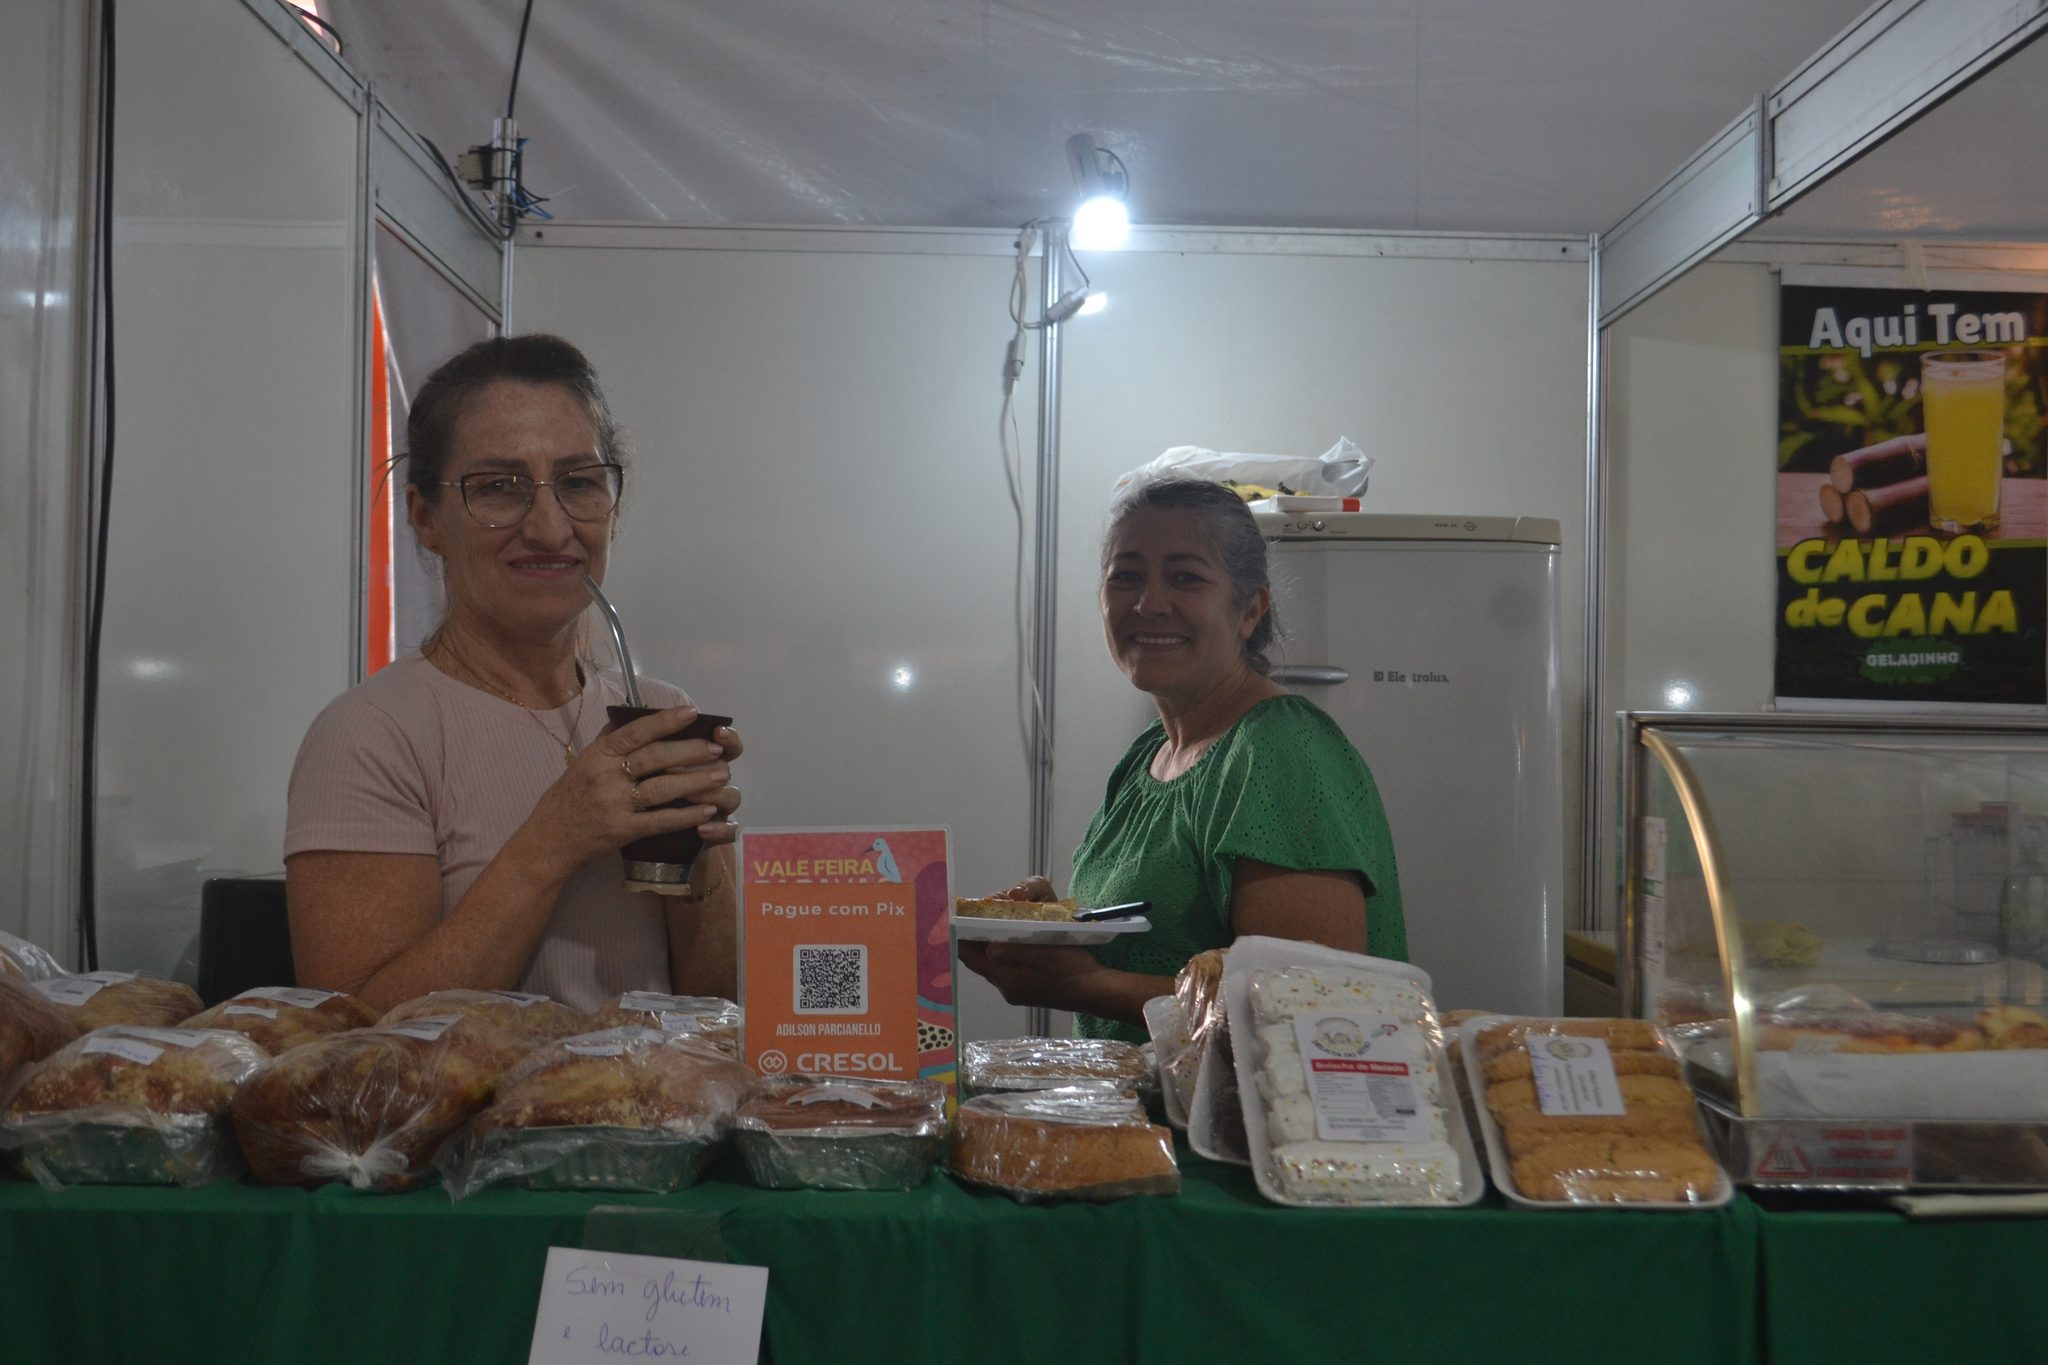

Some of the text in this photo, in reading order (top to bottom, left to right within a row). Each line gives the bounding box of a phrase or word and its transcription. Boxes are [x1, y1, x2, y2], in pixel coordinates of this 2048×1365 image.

[1808, 303, 2026, 358] Aqui Tem
[1786, 535, 1989, 583] CALDO
[1785, 588, 2019, 638] de CANA
[1866, 652, 1960, 667] GELADINHO
[754, 859, 874, 877] VALE FEIRA
[761, 902, 905, 919] Pague com Pix
[776, 1023, 881, 1036] ADILSON PARCIANELLO
[796, 1053, 903, 1073] CRESOL
[566, 1265, 625, 1297] Sem
